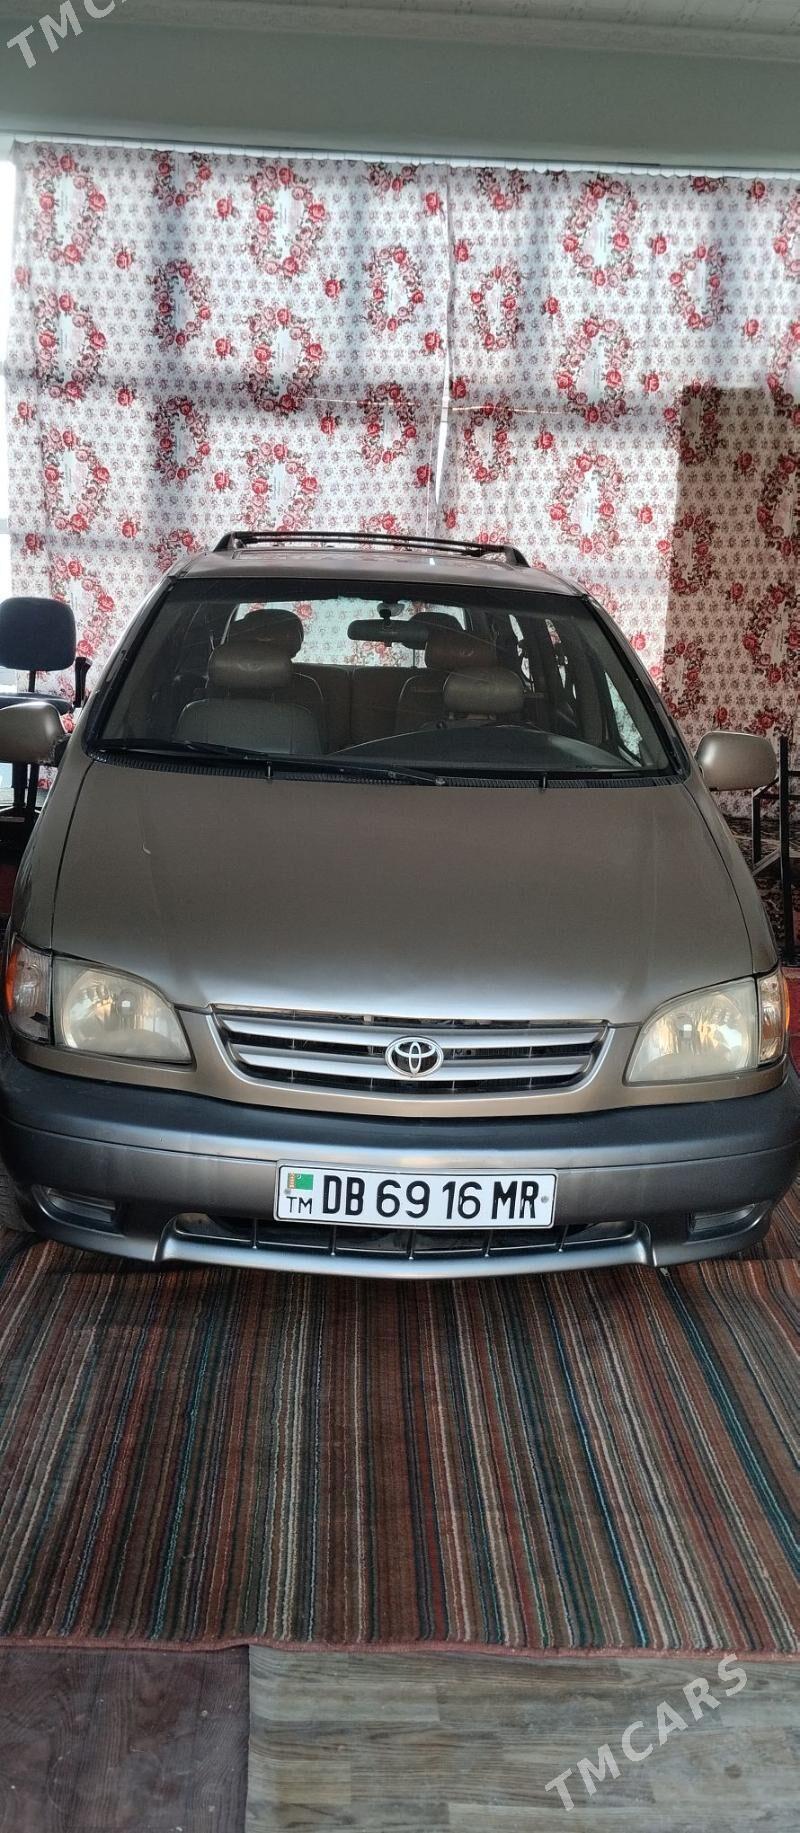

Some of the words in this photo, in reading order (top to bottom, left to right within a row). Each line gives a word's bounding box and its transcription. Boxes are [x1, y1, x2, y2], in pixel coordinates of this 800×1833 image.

[286, 1195, 312, 1214] TM
[322, 1174, 365, 1216] DB
[376, 1179, 430, 1219] 69
[442, 1180, 482, 1220] 16
[491, 1180, 540, 1220] MR
